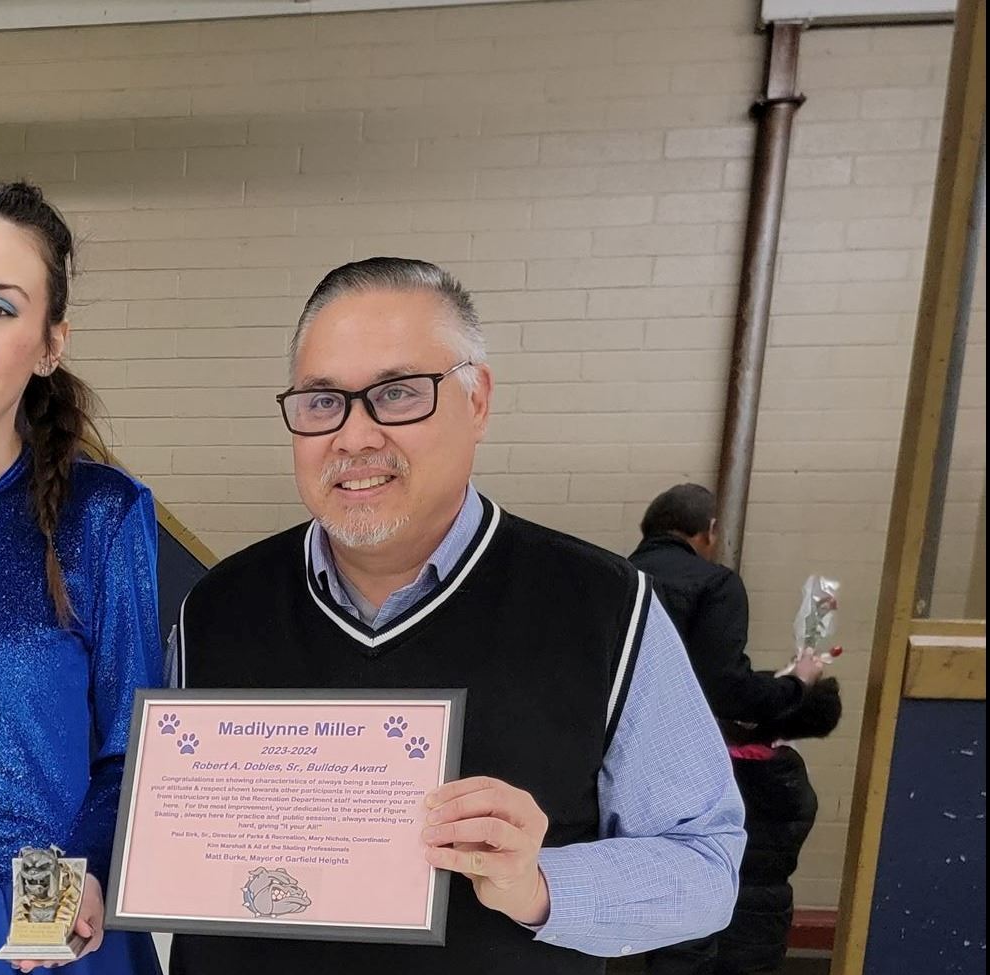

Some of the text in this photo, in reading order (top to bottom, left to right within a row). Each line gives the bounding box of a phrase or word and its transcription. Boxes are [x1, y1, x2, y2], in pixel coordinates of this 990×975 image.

[218, 721, 365, 738] Madilynne Miller
[260, 746, 317, 755] 2023-2024
[191, 760, 387, 774] Robert A. Dobies, Sr., Bulldog Award
[366, 788, 392, 796] skating
[342, 815, 366, 823] always
[367, 816, 396, 824] working
[271, 833, 307, 841] Recreation,
[223, 853, 247, 861] Burke,
[249, 854, 273, 862] Mayor
[285, 855, 317, 863] Garfield
[318, 856, 348, 865] Heights
